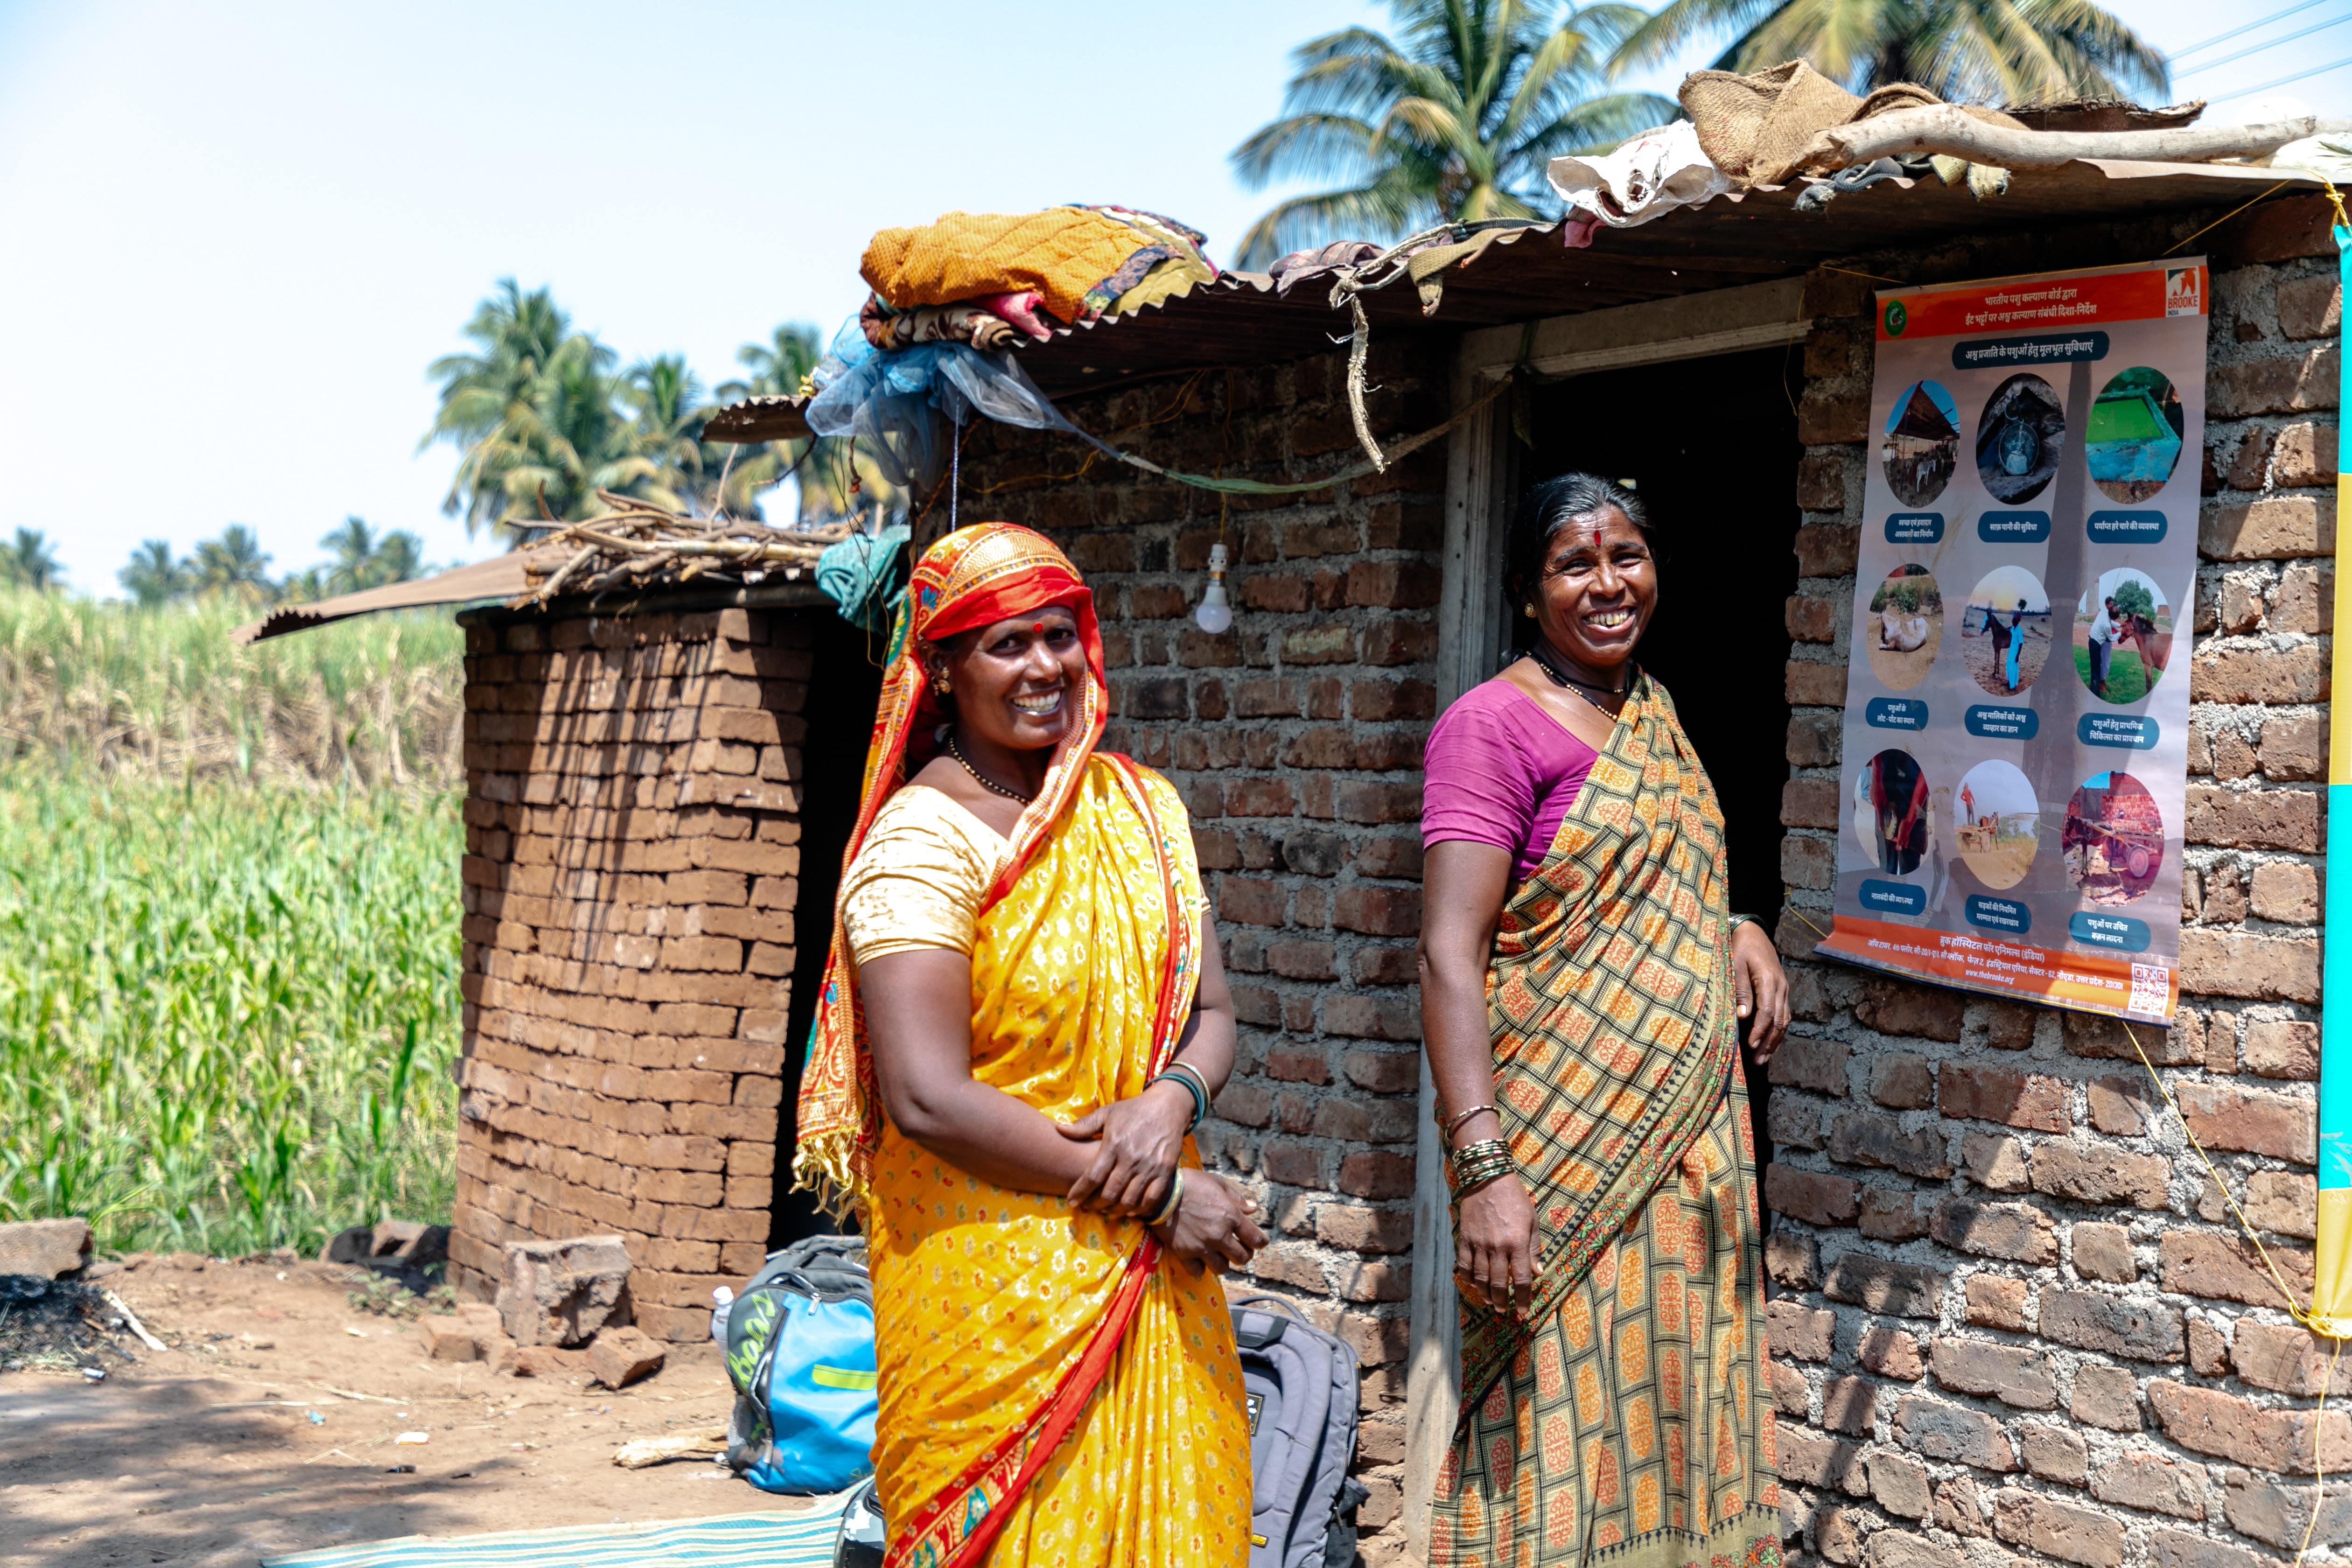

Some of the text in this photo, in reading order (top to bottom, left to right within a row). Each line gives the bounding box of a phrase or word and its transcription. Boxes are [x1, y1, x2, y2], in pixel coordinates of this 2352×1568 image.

[1985, 287, 2077, 306] भारतीय पशु कल्याण बोर्ड द्वारा
[2168, 295, 2198, 309] BROOKE
[1975, 311, 1988, 326] भट्टों
[1988, 313, 1996, 322] पर
[1998, 312, 2011, 322] अश्व
[2012, 310, 2037, 320] कल्याण
[2037, 305, 2057, 318] संबंधी
[2058, 302, 2097, 316] दिशा-निर्देश
[1966, 339, 2094, 361] अश्व प्रजाति के पशुओं हेतु मूलभूत सुविधाएं
[2002, 522, 2013, 530] पानी
[2013, 522, 2021, 530] की
[2021, 522, 2037, 533] सुविधा
[2093, 521, 2111, 530] पर्याप्त
[2119, 521, 2129, 530] चारे
[2129, 521, 2138, 530] की
[1888, 703, 1902, 713] पशुओं
[1977, 711, 2026, 723] अश्व मालिकों को अश्व
[2093, 719, 2143, 731] पशुओं हेतु प्राथमिक
[2090, 730, 2113, 741] चिकित्सा
[1871, 892, 1888, 901] नालबंदी
[1889, 894, 1895, 902] की
[1992, 903, 1999, 911] की
[1999, 903, 2016, 914] नियमित
[1976, 913, 1991, 922] मरम्मत
[2087, 919, 2105, 929] पशुओं
[2113, 922, 2128, 931] उचित
[2106, 935, 2123, 943] लादना
[1940, 936, 2044, 963] ब्रुक हॉस्पिटल फॉर एनिमल्स (इंडिया)
[1941, 950, 1947, 959] सी
[2012, 963, 2028, 974] एरिया,
[2076, 975, 2088, 984] उत्तर
[1966, 969, 2015, 985] www.thebrooke.org
[728, 1288, 776, 1400] bags
